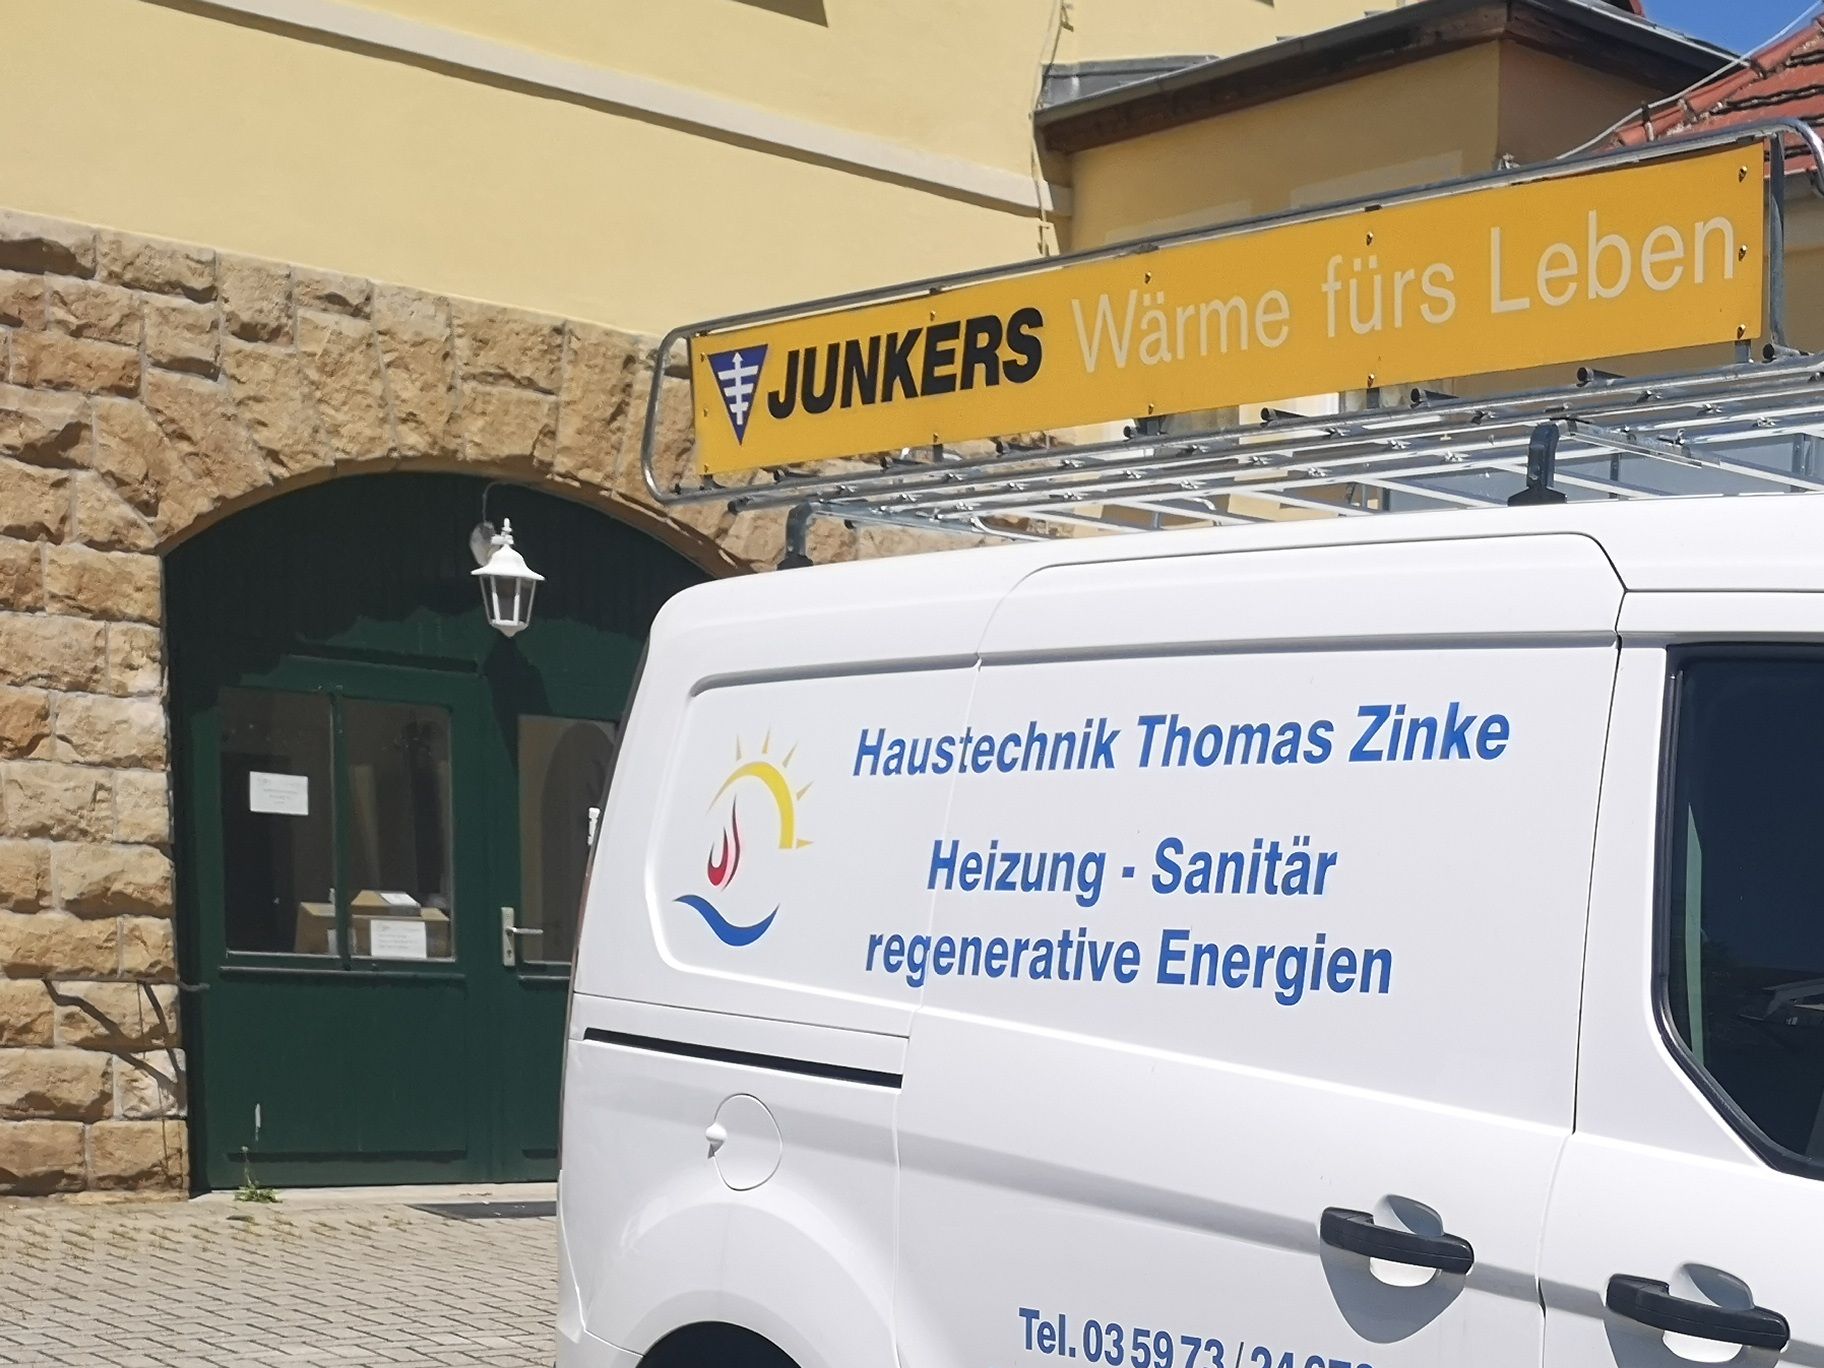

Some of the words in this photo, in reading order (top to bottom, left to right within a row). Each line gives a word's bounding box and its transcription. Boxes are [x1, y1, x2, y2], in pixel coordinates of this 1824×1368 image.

[766, 307, 1044, 420] JUNKERS
[1070, 290, 1291, 374] Wärme
[1321, 255, 1457, 338] fürs
[1490, 209, 1735, 315] Leben
[853, 718, 1119, 777] Haustechnik
[1136, 714, 1335, 769] Thomas
[1348, 701, 1512, 763] Zinke
[927, 839, 1107, 908] Heizung
[1151, 836, 1339, 897] Sanitär
[865, 929, 1142, 989] regenerative
[1156, 928, 1394, 1007] Energien
[1017, 1306, 1077, 1359] Tel.
